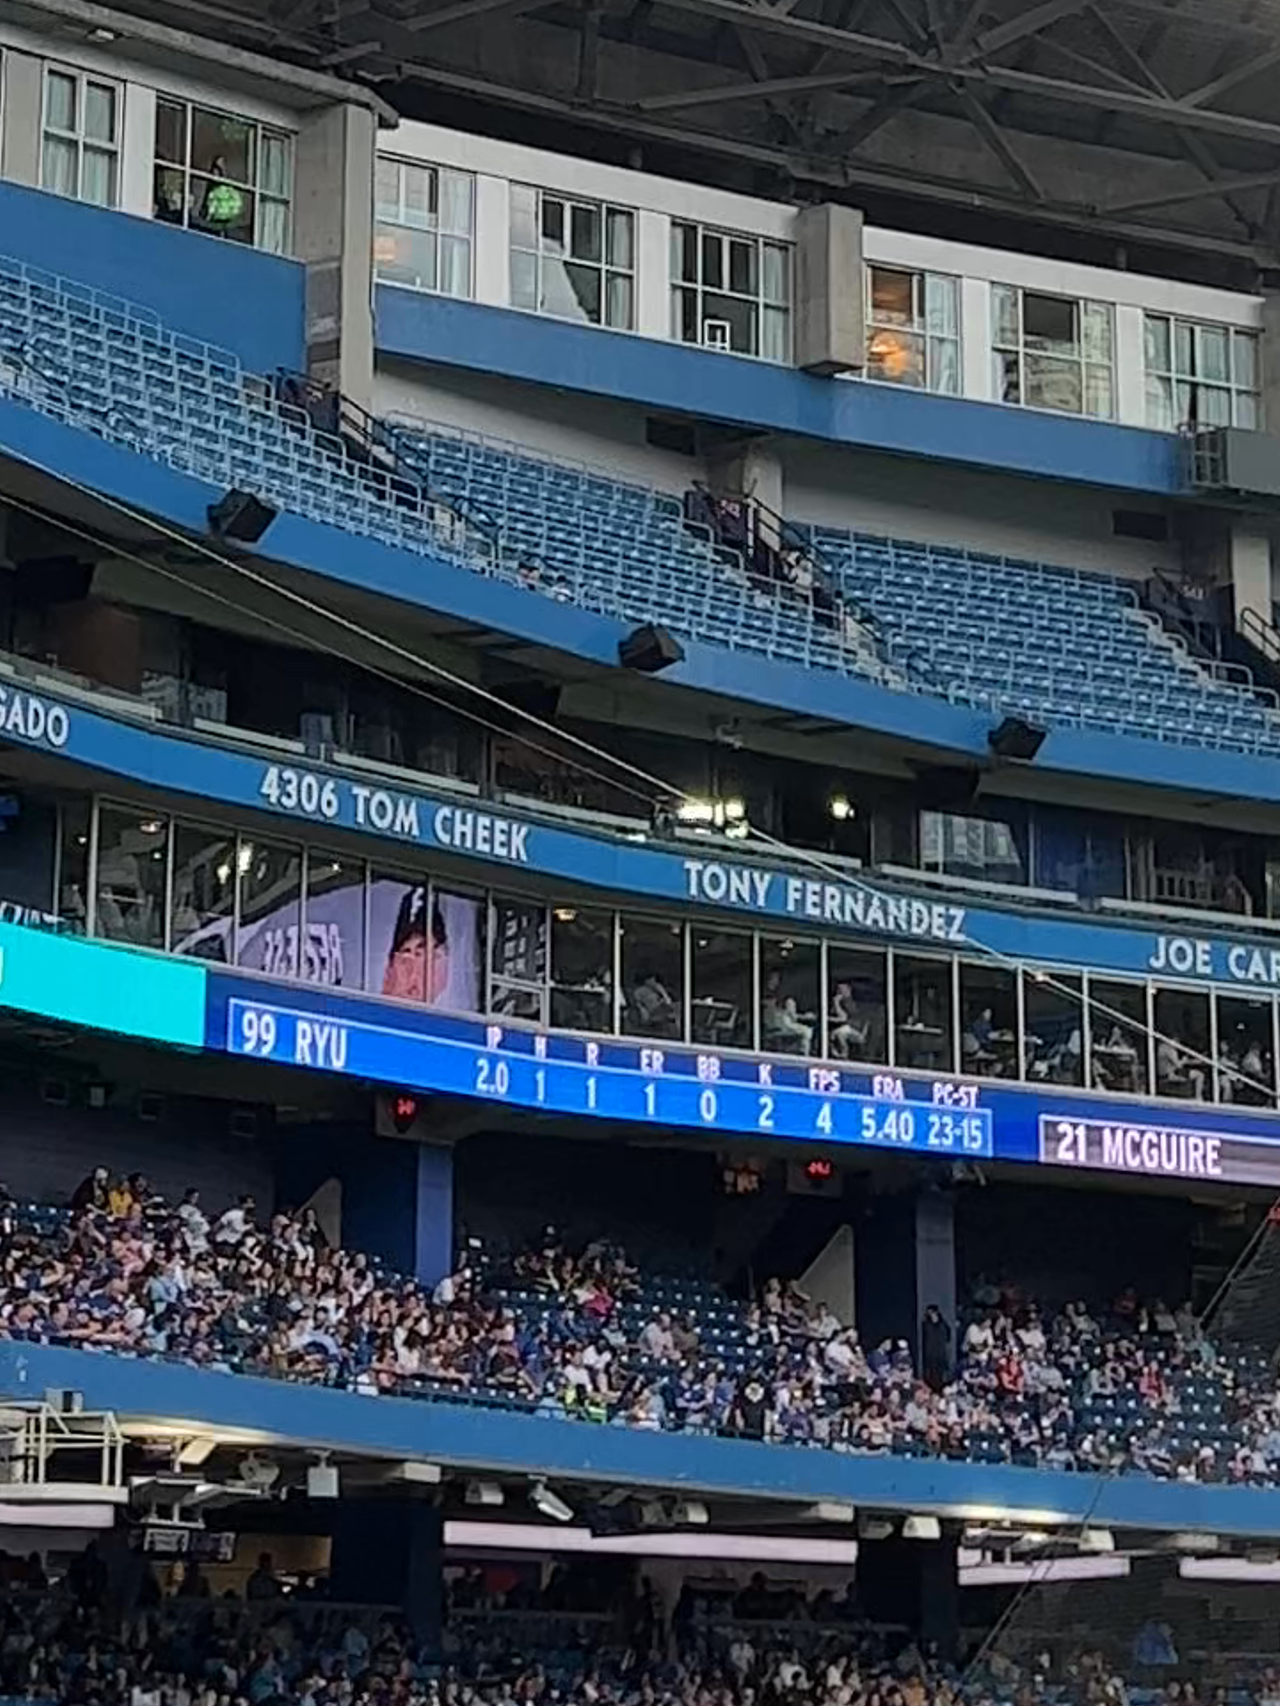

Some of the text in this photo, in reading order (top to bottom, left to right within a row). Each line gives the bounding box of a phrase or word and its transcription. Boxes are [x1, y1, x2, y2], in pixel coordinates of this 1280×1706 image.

[260, 767, 529, 862] 4306 TOM CHEEK
[684, 860, 966, 940] TONY FERNANDEZ
[1149, 937, 1212, 974] JOE
[242, 1011, 983, 1149] 99 RYU 2.0 1 1 1 0 2 4 5.40 23-15
[586, 1042, 600, 1066] R
[640, 1049, 664, 1076] ER
[758, 1064, 772, 1086] K
[873, 1075, 905, 1101] ERA
[932, 1082, 979, 1108] PC-ST
[1056, 1123, 1087, 1162] 21
[1102, 1127, 1222, 1175] MCGUIRE
